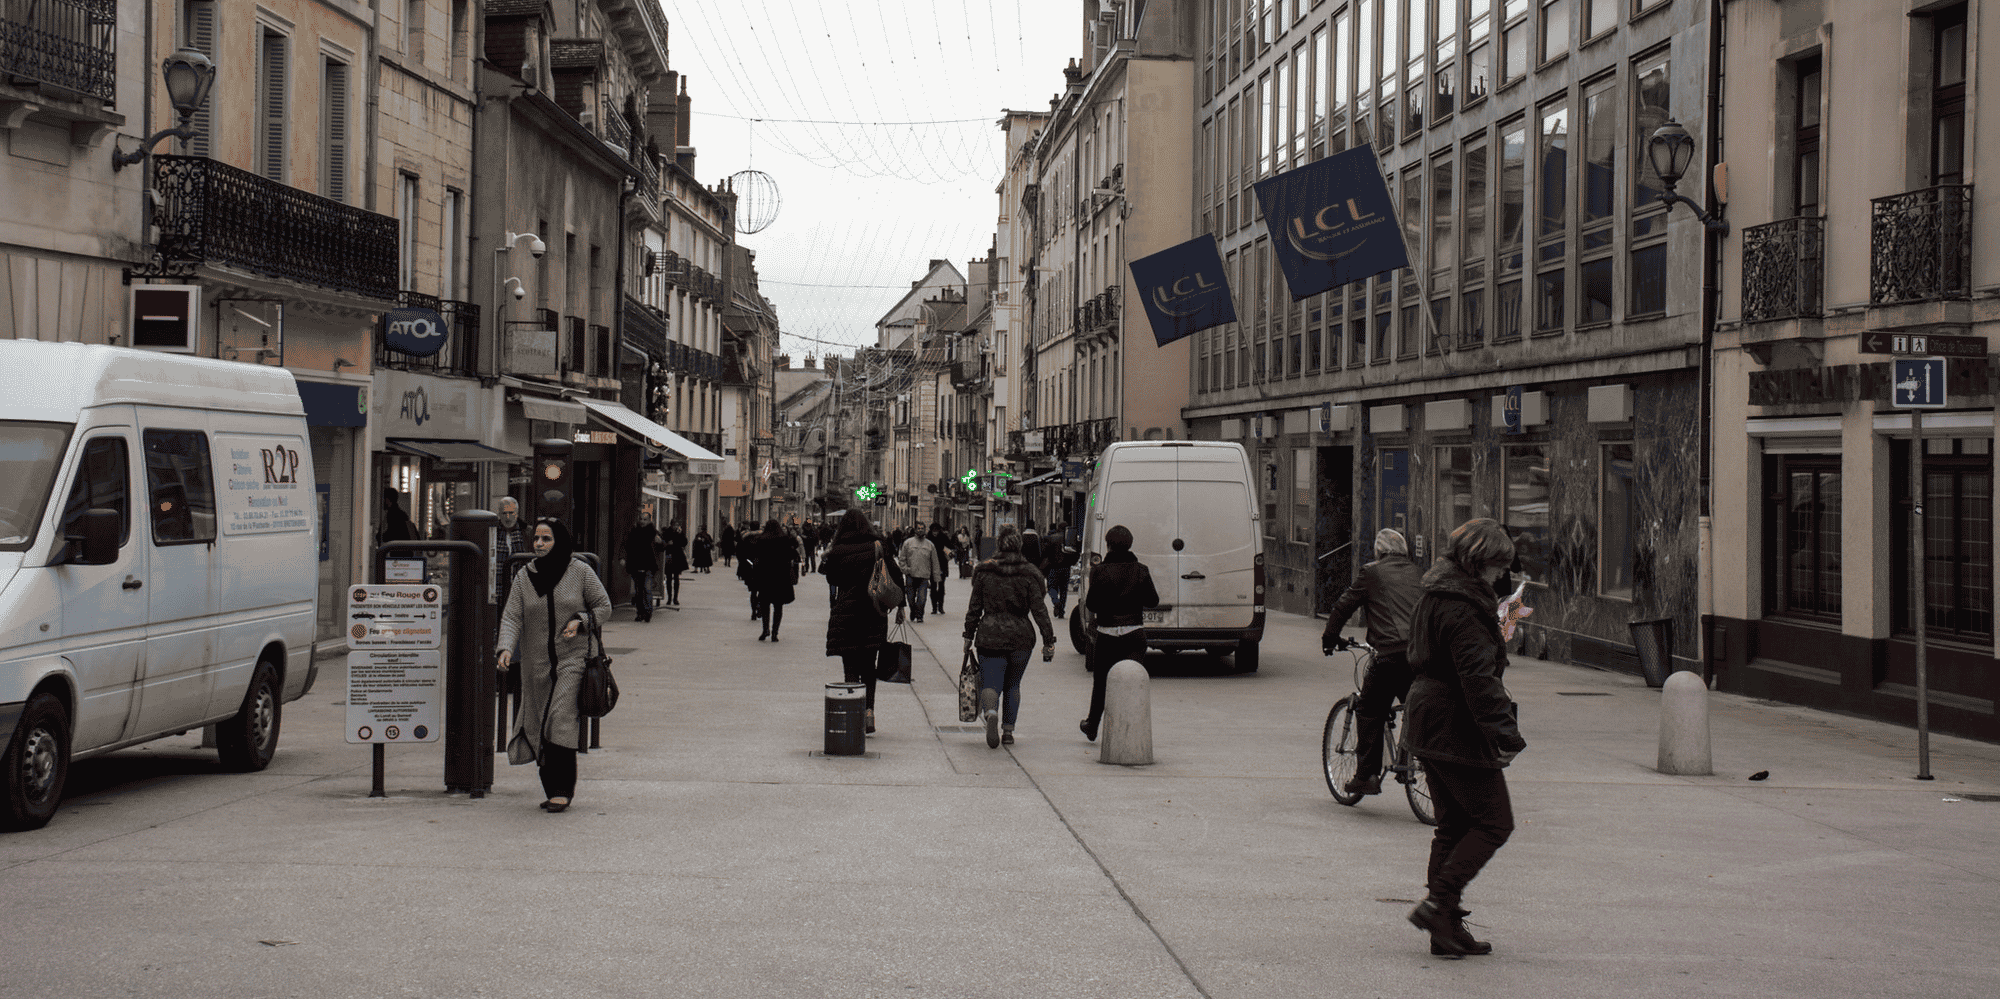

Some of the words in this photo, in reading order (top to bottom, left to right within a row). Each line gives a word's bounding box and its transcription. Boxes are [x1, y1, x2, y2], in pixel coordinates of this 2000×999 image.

[1293, 198, 1375, 239] LCL
[1157, 272, 1215, 302] LCL
[388, 318, 441, 338] ATOL
[1930, 339, 1947, 352] Office
[1948, 341, 1956, 353] de
[1956, 340, 1983, 354] Tourisme
[401, 385, 430, 426] ATOL
[1505, 395, 1520, 411] LCL
[260, 444, 299, 484] R2P
[396, 591, 421, 599] Rouge
